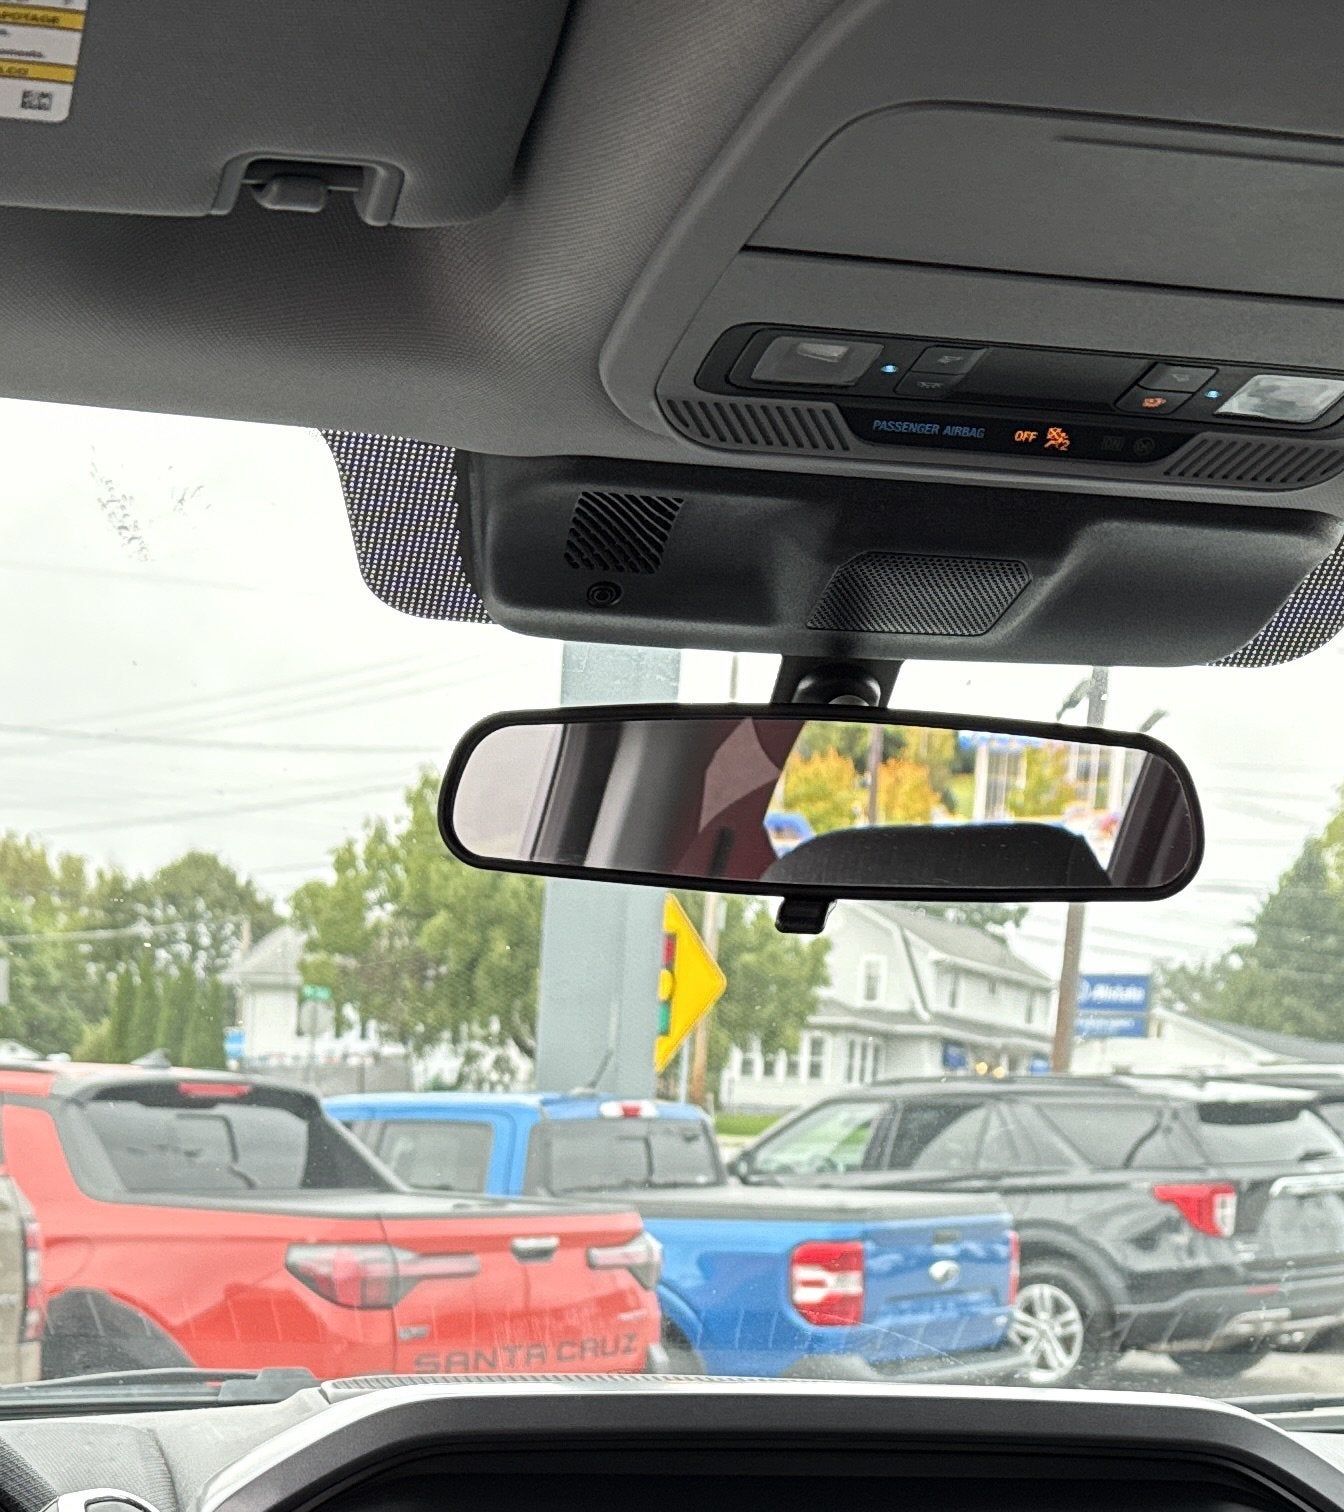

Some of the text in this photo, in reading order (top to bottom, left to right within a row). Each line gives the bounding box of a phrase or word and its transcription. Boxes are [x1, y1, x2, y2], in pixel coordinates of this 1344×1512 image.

[872, 420, 939, 435] PASSENGER
[942, 426, 985, 438] AIRBAG
[1014, 430, 1038, 442] OFF
[414, 1331, 637, 1374] SANTA CRUZ
